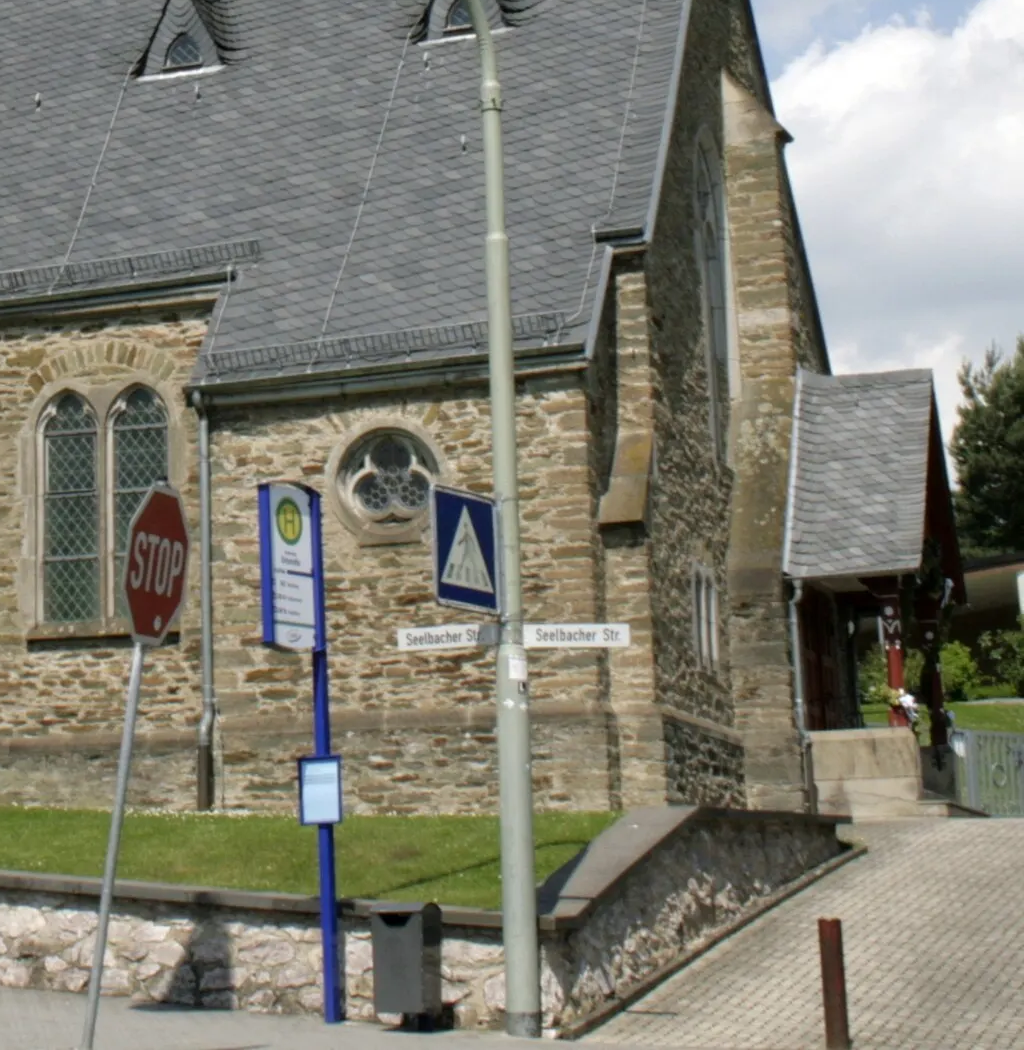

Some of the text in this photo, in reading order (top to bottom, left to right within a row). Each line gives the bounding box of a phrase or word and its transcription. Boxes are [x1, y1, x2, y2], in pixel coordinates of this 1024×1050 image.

[130, 531, 183, 598] STOP
[406, 629, 485, 646] Seelbacher Str.
[535, 628, 621, 642] Seelbacher Str.
